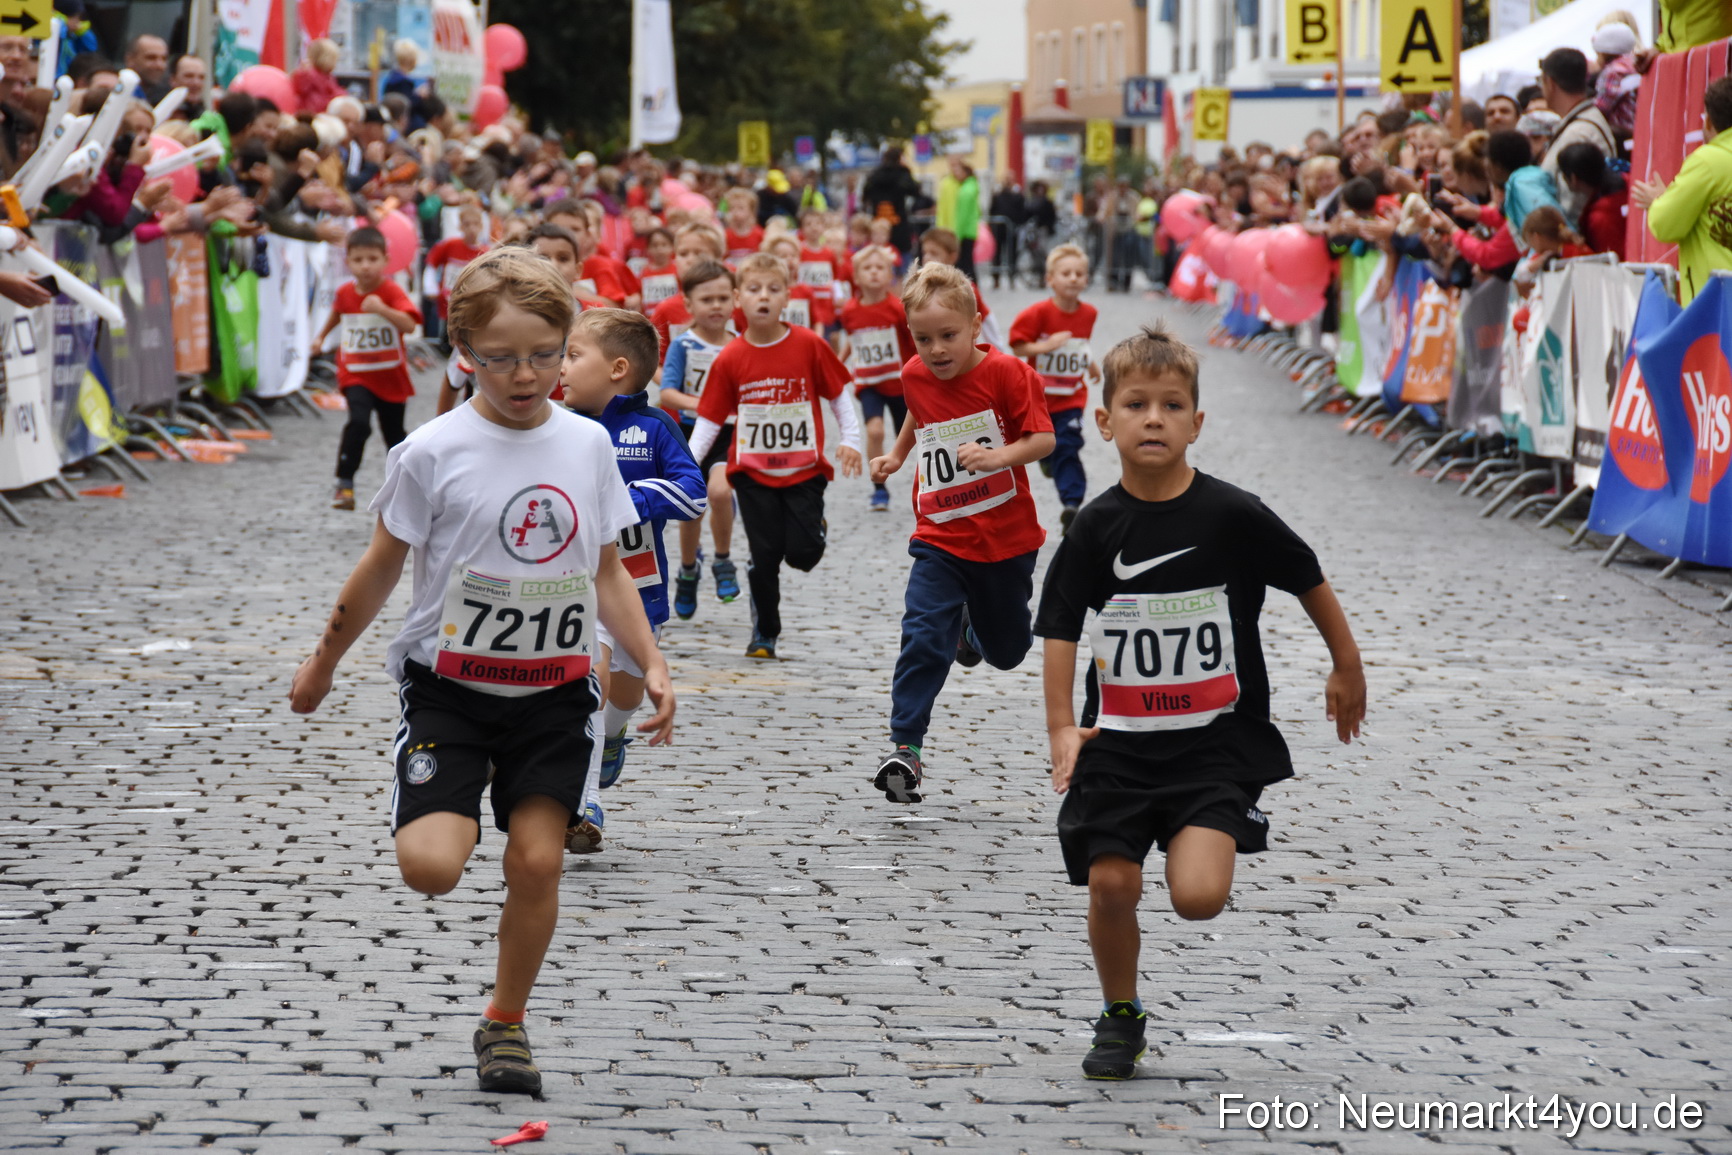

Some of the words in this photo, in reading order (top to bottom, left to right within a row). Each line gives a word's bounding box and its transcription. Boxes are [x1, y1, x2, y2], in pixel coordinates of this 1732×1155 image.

[1301, 5, 1328, 43] B
[1398, 8, 1443, 64] A
[1202, 103, 1221, 130] C
[348, 326, 393, 349] 7250
[855, 342, 894, 365] 7034
[1044, 352, 1088, 373] 7064
[746, 420, 809, 449] 7094
[938, 416, 988, 439] BOCK
[616, 447, 648, 456] MEIER
[936, 482, 990, 508] Leopold
[462, 580, 511, 597] NeuerMarkt
[521, 575, 587, 596] BOCK
[1148, 591, 1217, 615] BOCK
[462, 598, 585, 652] 7216
[445, 641, 450, 649] 2
[582, 644, 588, 653] K
[1103, 621, 1222, 678] 7079
[460, 660, 566, 681] Konstantin
[1142, 692, 1192, 711] Vitus
